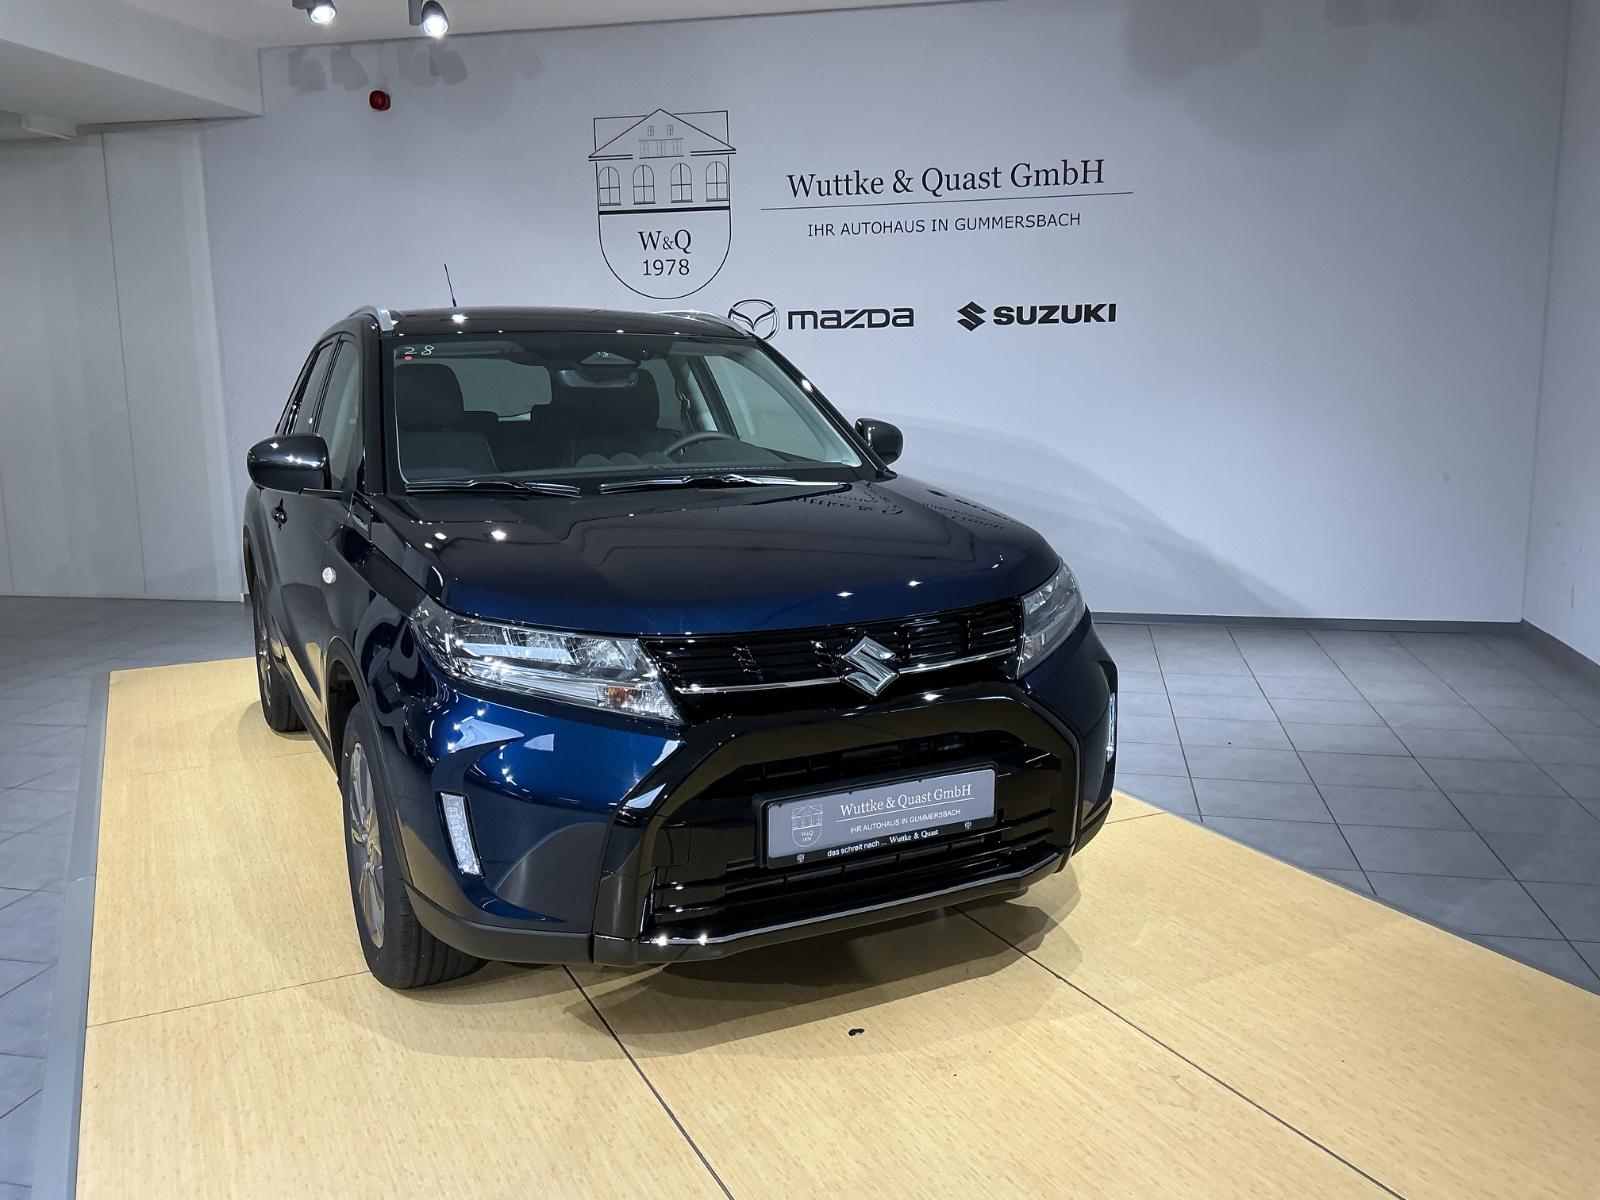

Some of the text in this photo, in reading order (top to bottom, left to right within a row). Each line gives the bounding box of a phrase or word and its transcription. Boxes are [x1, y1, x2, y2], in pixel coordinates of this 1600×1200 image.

[786, 158, 1105, 199] Wuttke & Quast GmbH
[807, 212, 1081, 238] IHR AUTOHAUS IN GUMMERSBACH
[637, 229, 692, 254] W&Q
[642, 258, 690, 276] 1978
[787, 307, 915, 331] mazda
[992, 303, 1117, 326] SUZUKI
[840, 783, 972, 817] Wuttke & Quast GmbH
[850, 808, 961, 835] IHR AUTOHAUS IN GUMMERSBACH
[827, 848, 840, 857] das
[913, 831, 920, 840] &
[920, 828, 939, 838] Quast
